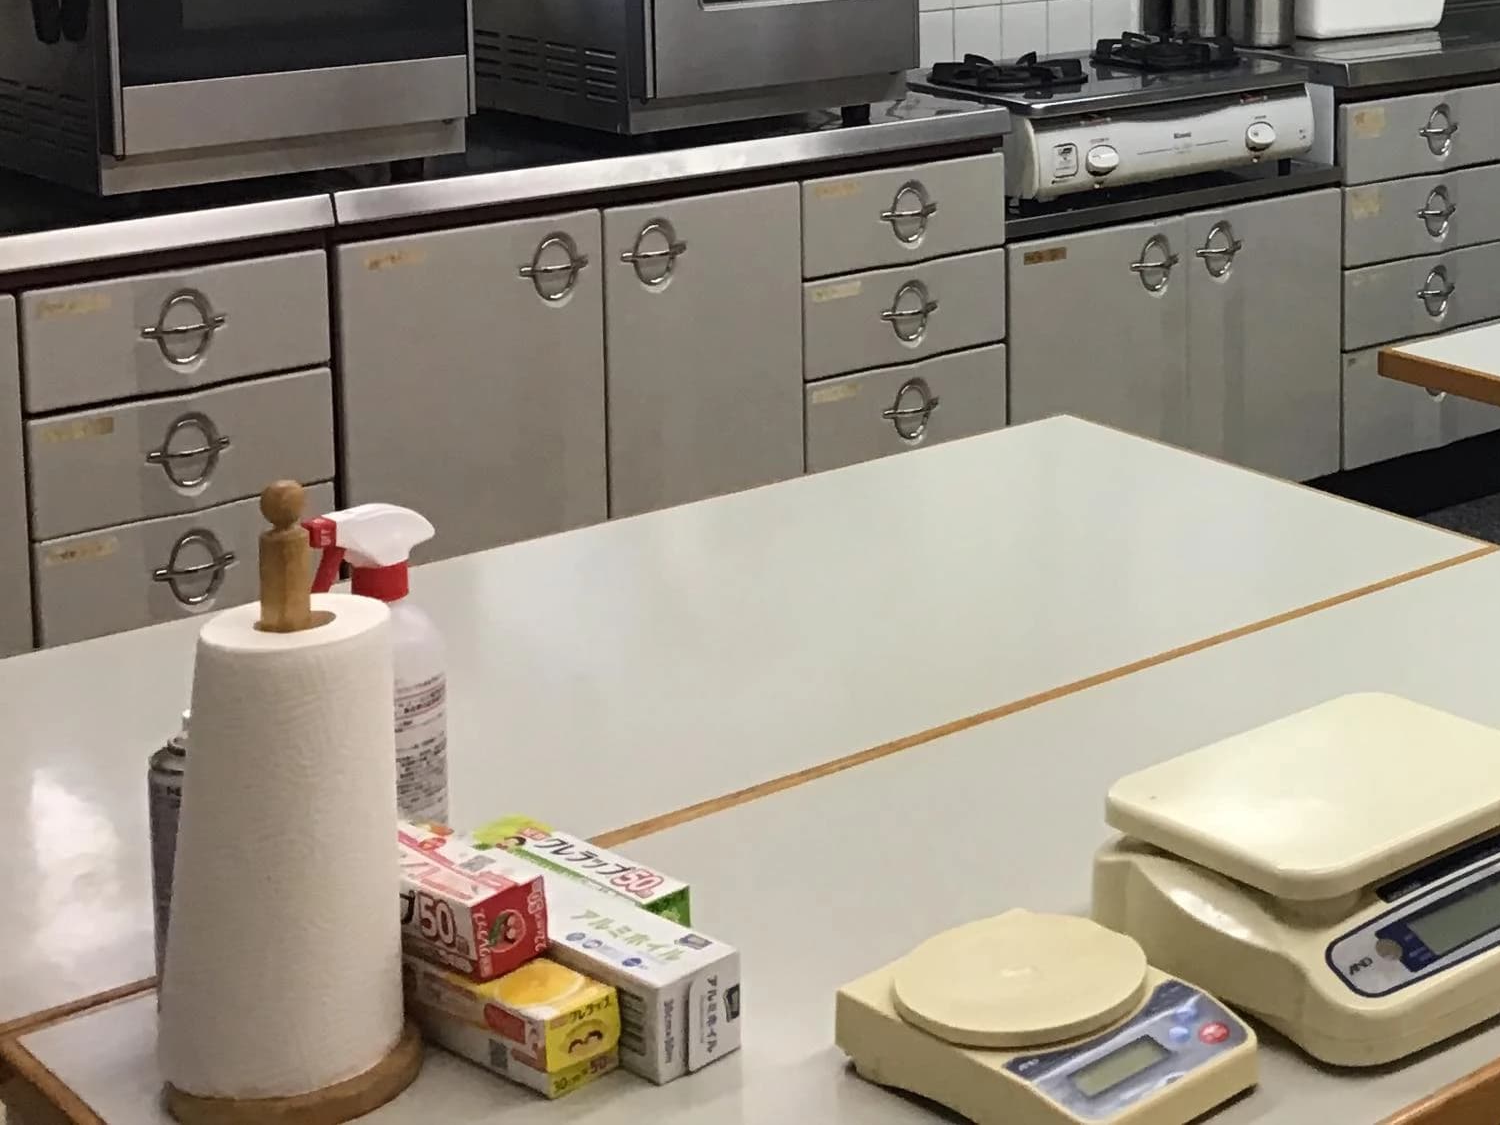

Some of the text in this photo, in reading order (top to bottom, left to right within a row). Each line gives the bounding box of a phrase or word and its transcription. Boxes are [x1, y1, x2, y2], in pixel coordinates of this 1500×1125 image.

[534, 837, 634, 876] クレラップ
[570, 908, 685, 962] アルミホイル
